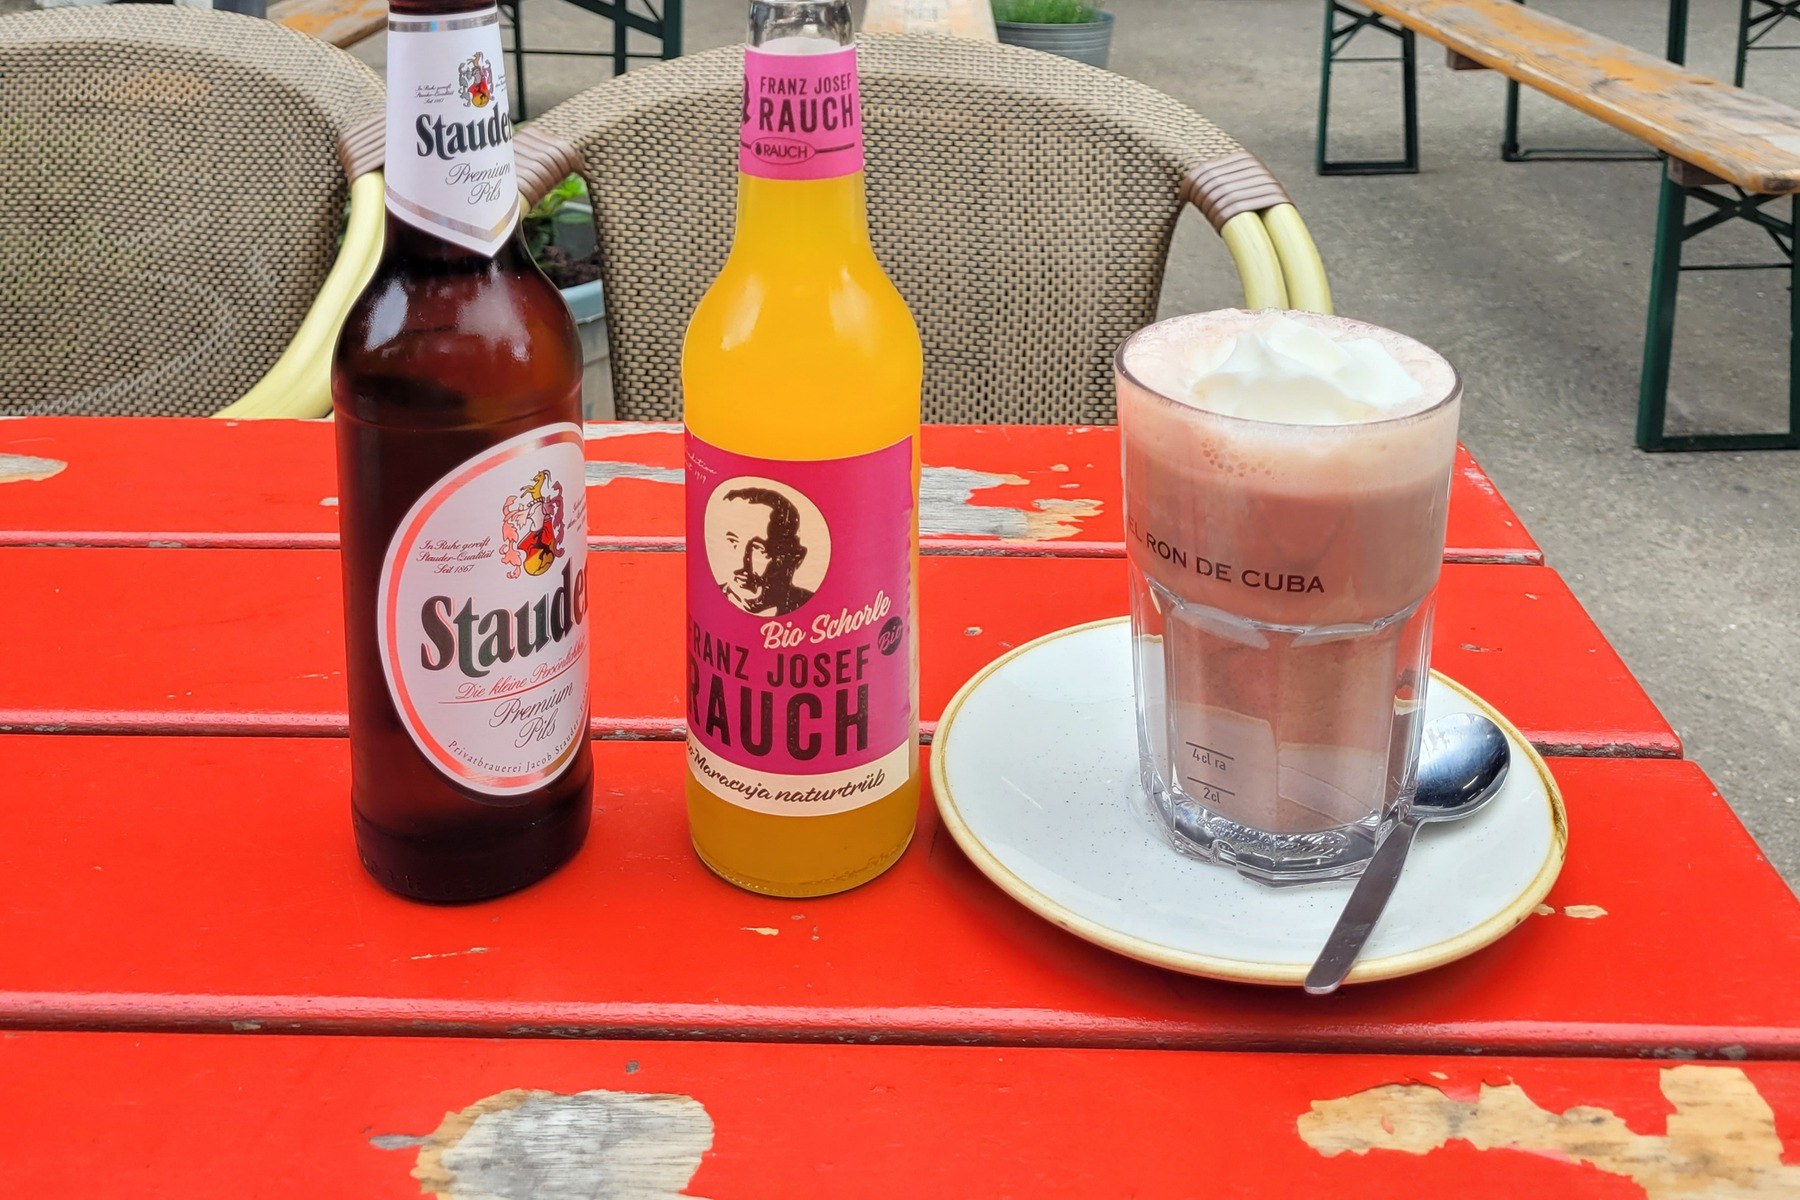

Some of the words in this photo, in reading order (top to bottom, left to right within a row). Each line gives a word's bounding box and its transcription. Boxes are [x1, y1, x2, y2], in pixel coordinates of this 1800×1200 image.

[761, 76, 807, 95] FRANZ
[814, 73, 851, 94] JOSEF
[759, 93, 853, 133] RAUCH
[763, 144, 808, 159] RAUCH
[445, 161, 511, 186] Premium
[467, 178, 502, 205] Pils
[416, 549, 495, 562] Stauder-Qualität
[418, 539, 434, 550] In
[434, 539, 462, 551] Ruhe
[460, 535, 491, 553] gereift
[433, 563, 455, 574] Seit
[454, 564, 475, 574] 1867
[1146, 531, 1187, 569] RON
[1196, 557, 1232, 582] DE
[1241, 570, 1325, 593] CUBA
[760, 620, 806, 649] Bio
[810, 589, 891, 644] Schorle
[689, 614, 750, 682] RANZ
[767, 644, 871, 689] JOSEF
[455, 682, 486, 699] Die
[489, 676, 528, 695] kleine
[488, 681, 574, 728] Premium
[687, 650, 869, 761] RAUCH
[514, 707, 557, 749] Pils
[448, 740, 522, 774] Privatbrauerei
[525, 753, 552, 773] Jacob
[555, 721, 580, 756] Stauder
[1192, 748, 1212, 766] 4cl
[1215, 759, 1227, 771] ra
[774, 768, 886, 803] naturtrüb
[1203, 787, 1221, 804] 2cl
